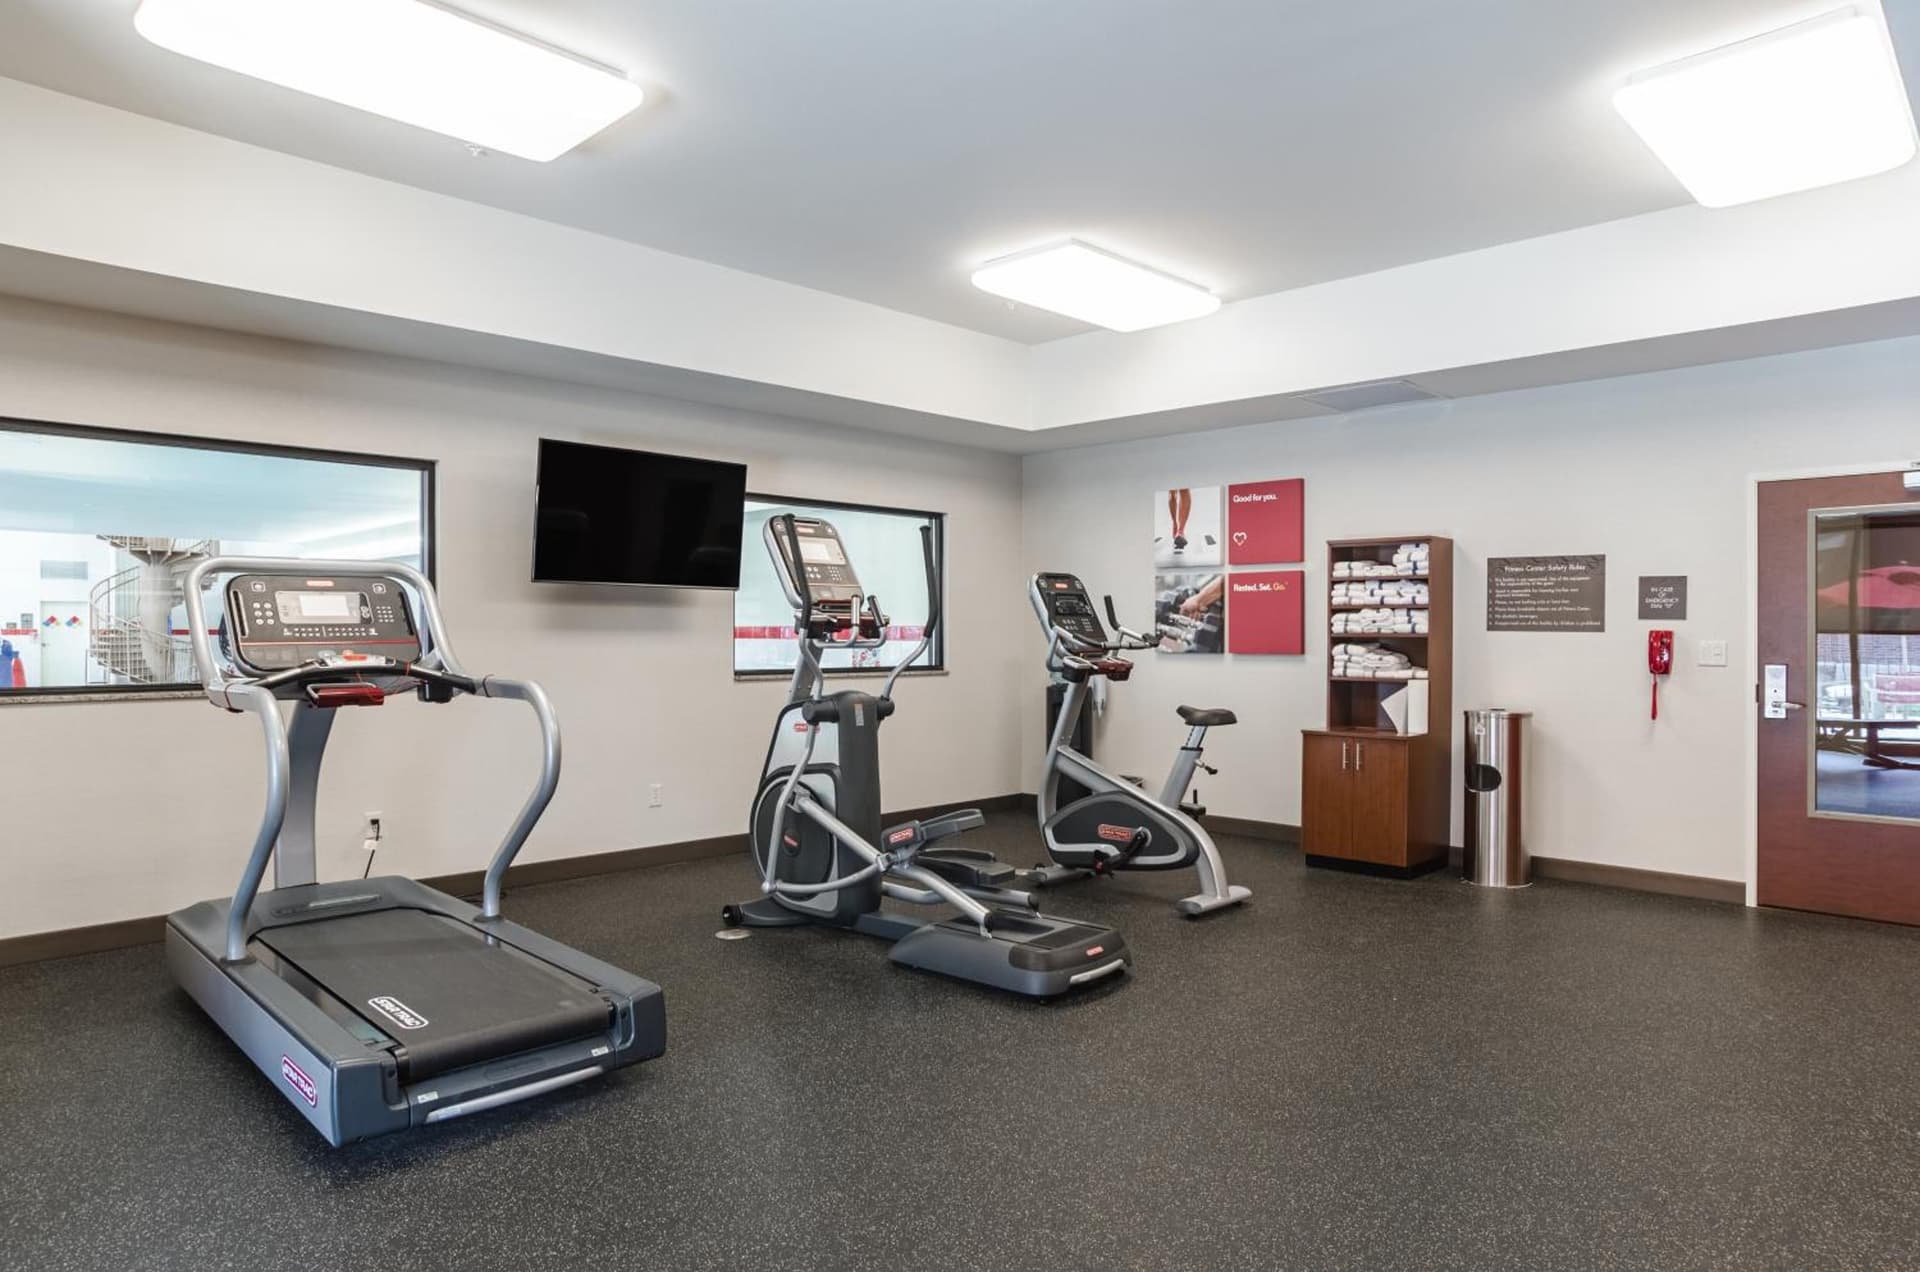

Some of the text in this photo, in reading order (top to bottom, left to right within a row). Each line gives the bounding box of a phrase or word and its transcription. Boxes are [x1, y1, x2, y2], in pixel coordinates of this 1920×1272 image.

[1233, 493, 1279, 503] Good for you.
[1548, 563, 1567, 572] Safety
[1233, 583, 1258, 592] Rested.
[1258, 582, 1272, 592] Set.
[374, 998, 421, 1026] STAR TRAC
